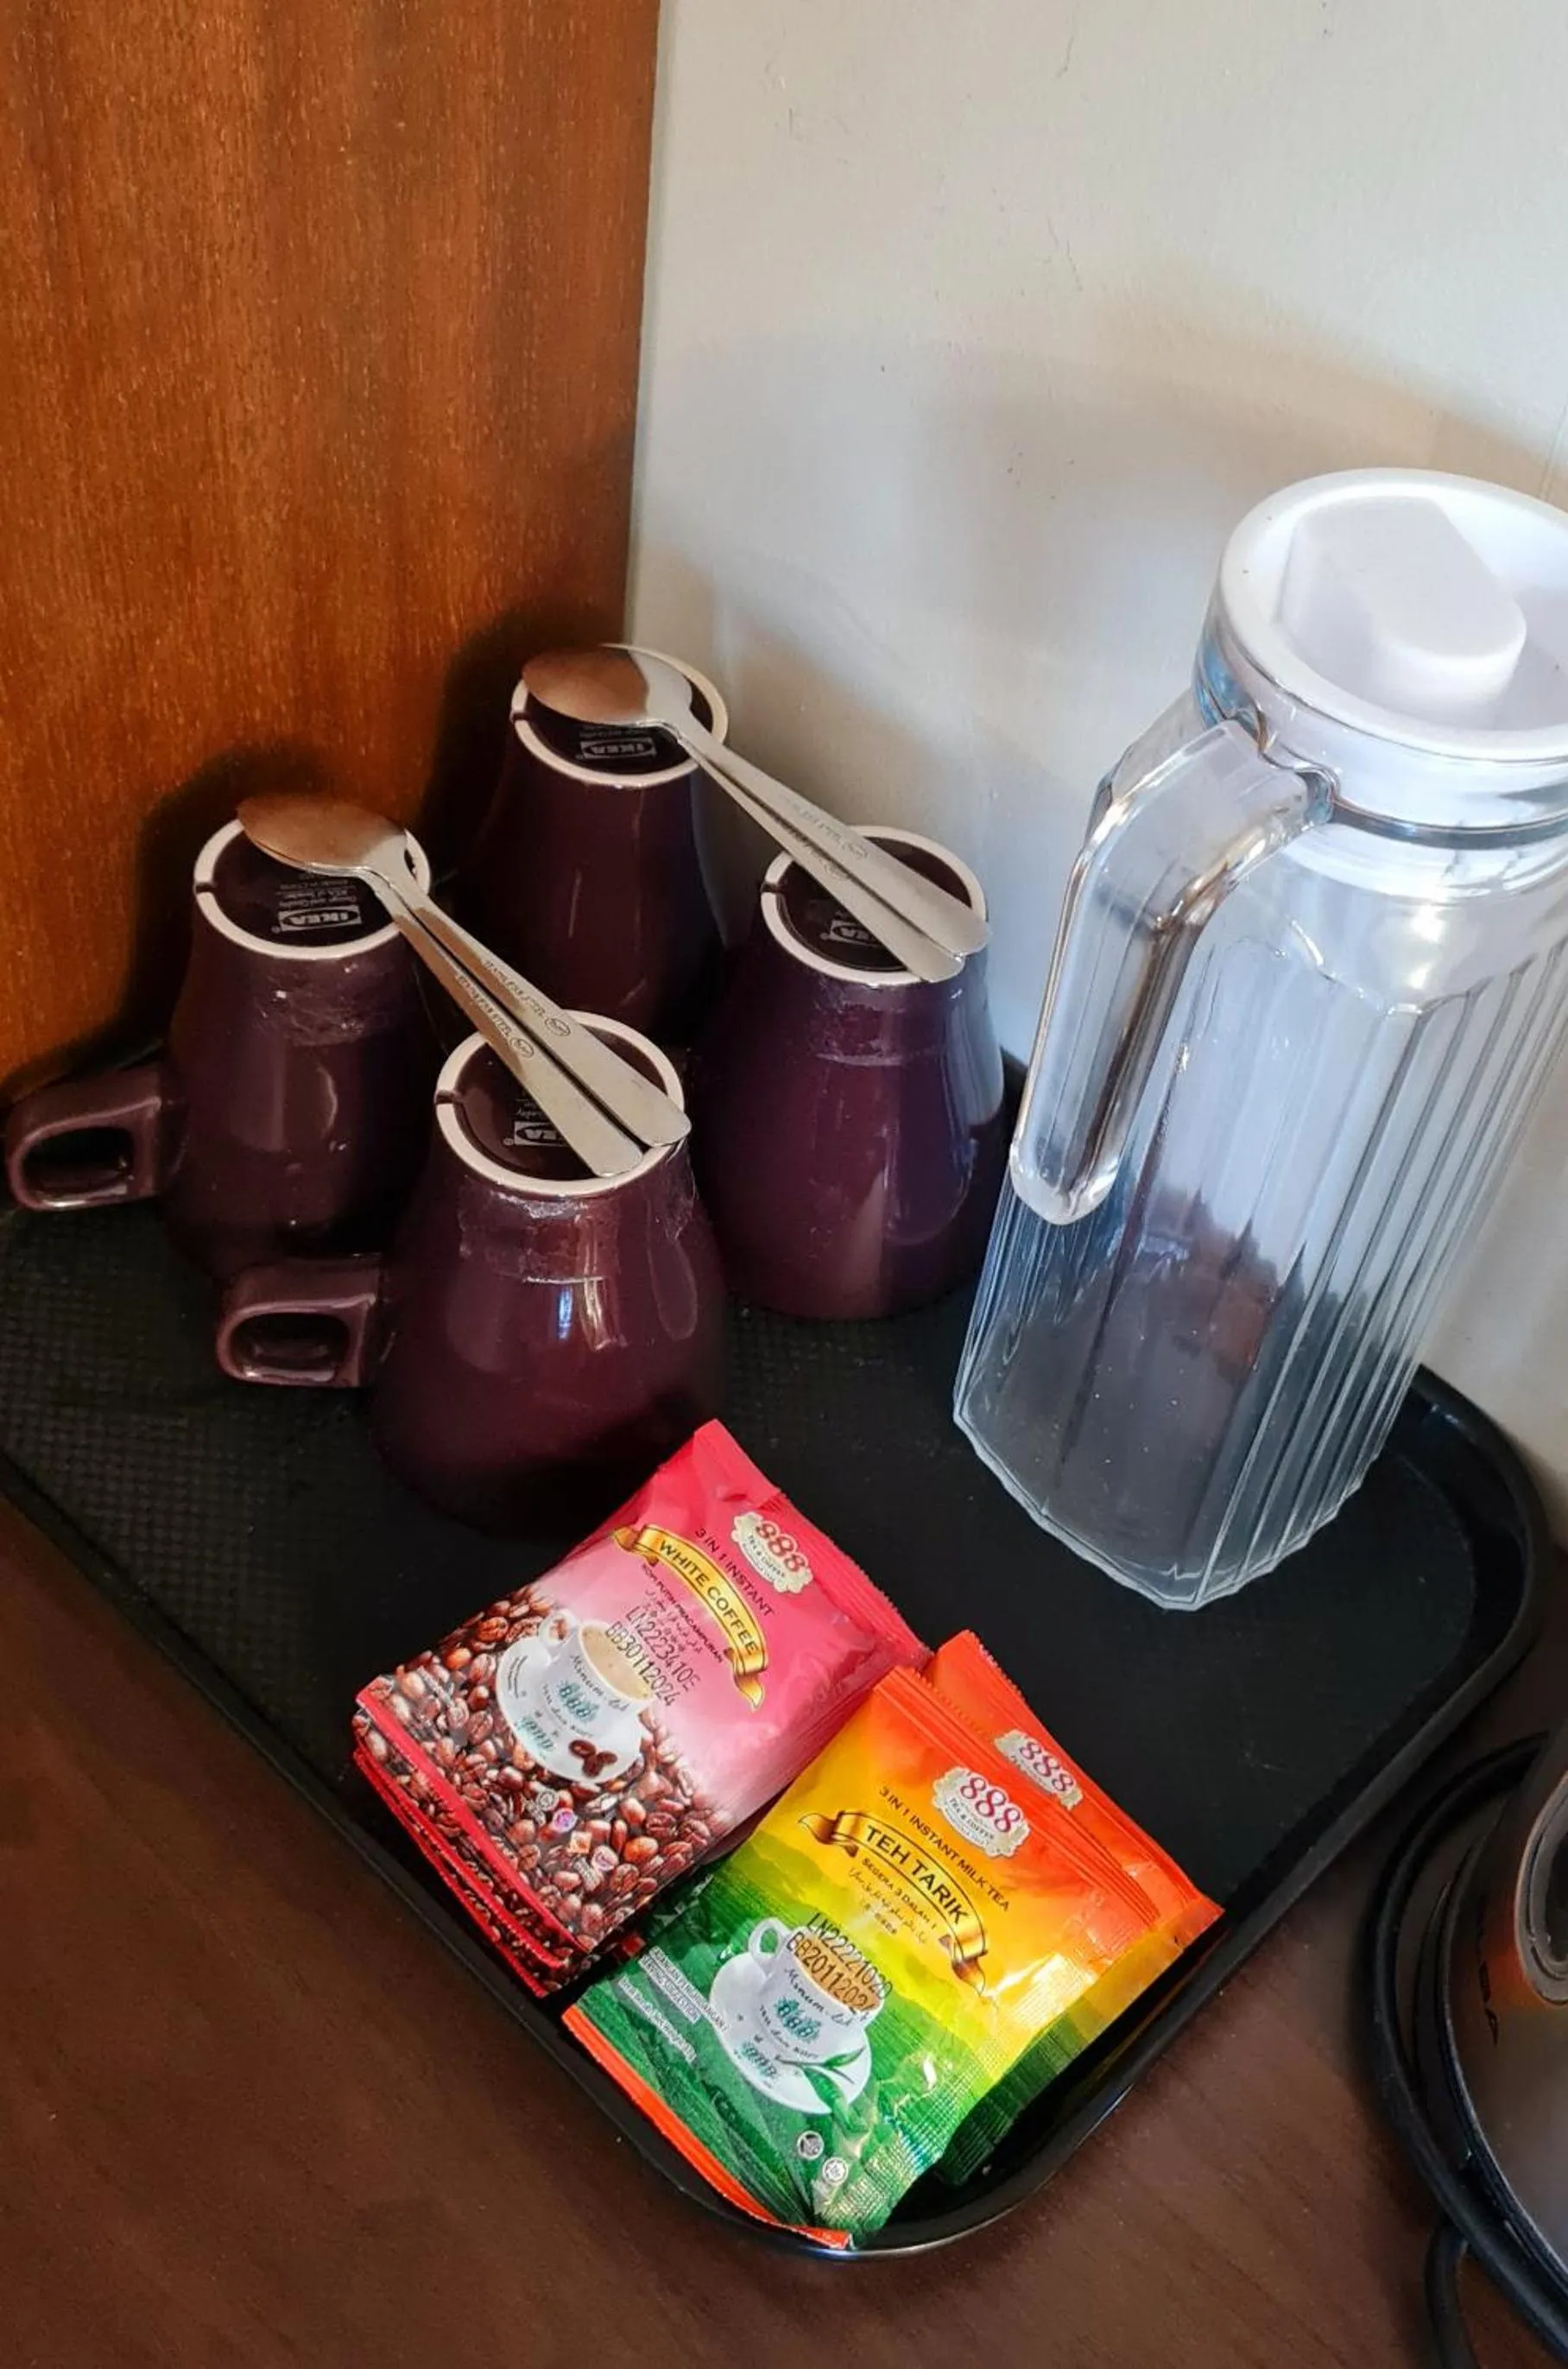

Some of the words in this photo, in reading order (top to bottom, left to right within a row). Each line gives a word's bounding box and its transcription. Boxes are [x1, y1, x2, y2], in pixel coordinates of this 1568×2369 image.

[694, 1526, 708, 1539] 3
[702, 1535, 720, 1554] IN
[722, 1559, 775, 1619] INSTANT
[755, 1521, 806, 1573] 888
[659, 1540, 707, 1586] WHITE
[705, 1585, 760, 1656] COFFEE
[604, 1620, 681, 1707] BB30112024
[623, 1605, 702, 1693] LN2223410E
[958, 1774, 1022, 1834] 888
[1018, 1739, 1076, 1794] 888
[863, 1825, 911, 1865] TEH
[907, 1859, 968, 1925] TARIK
[877, 1786, 890, 1798] 3
[886, 1793, 904, 1811] IN
[907, 1814, 959, 1863] INSTANT
[956, 1859, 988, 1889] MILK
[984, 1884, 1008, 1912] TEA
